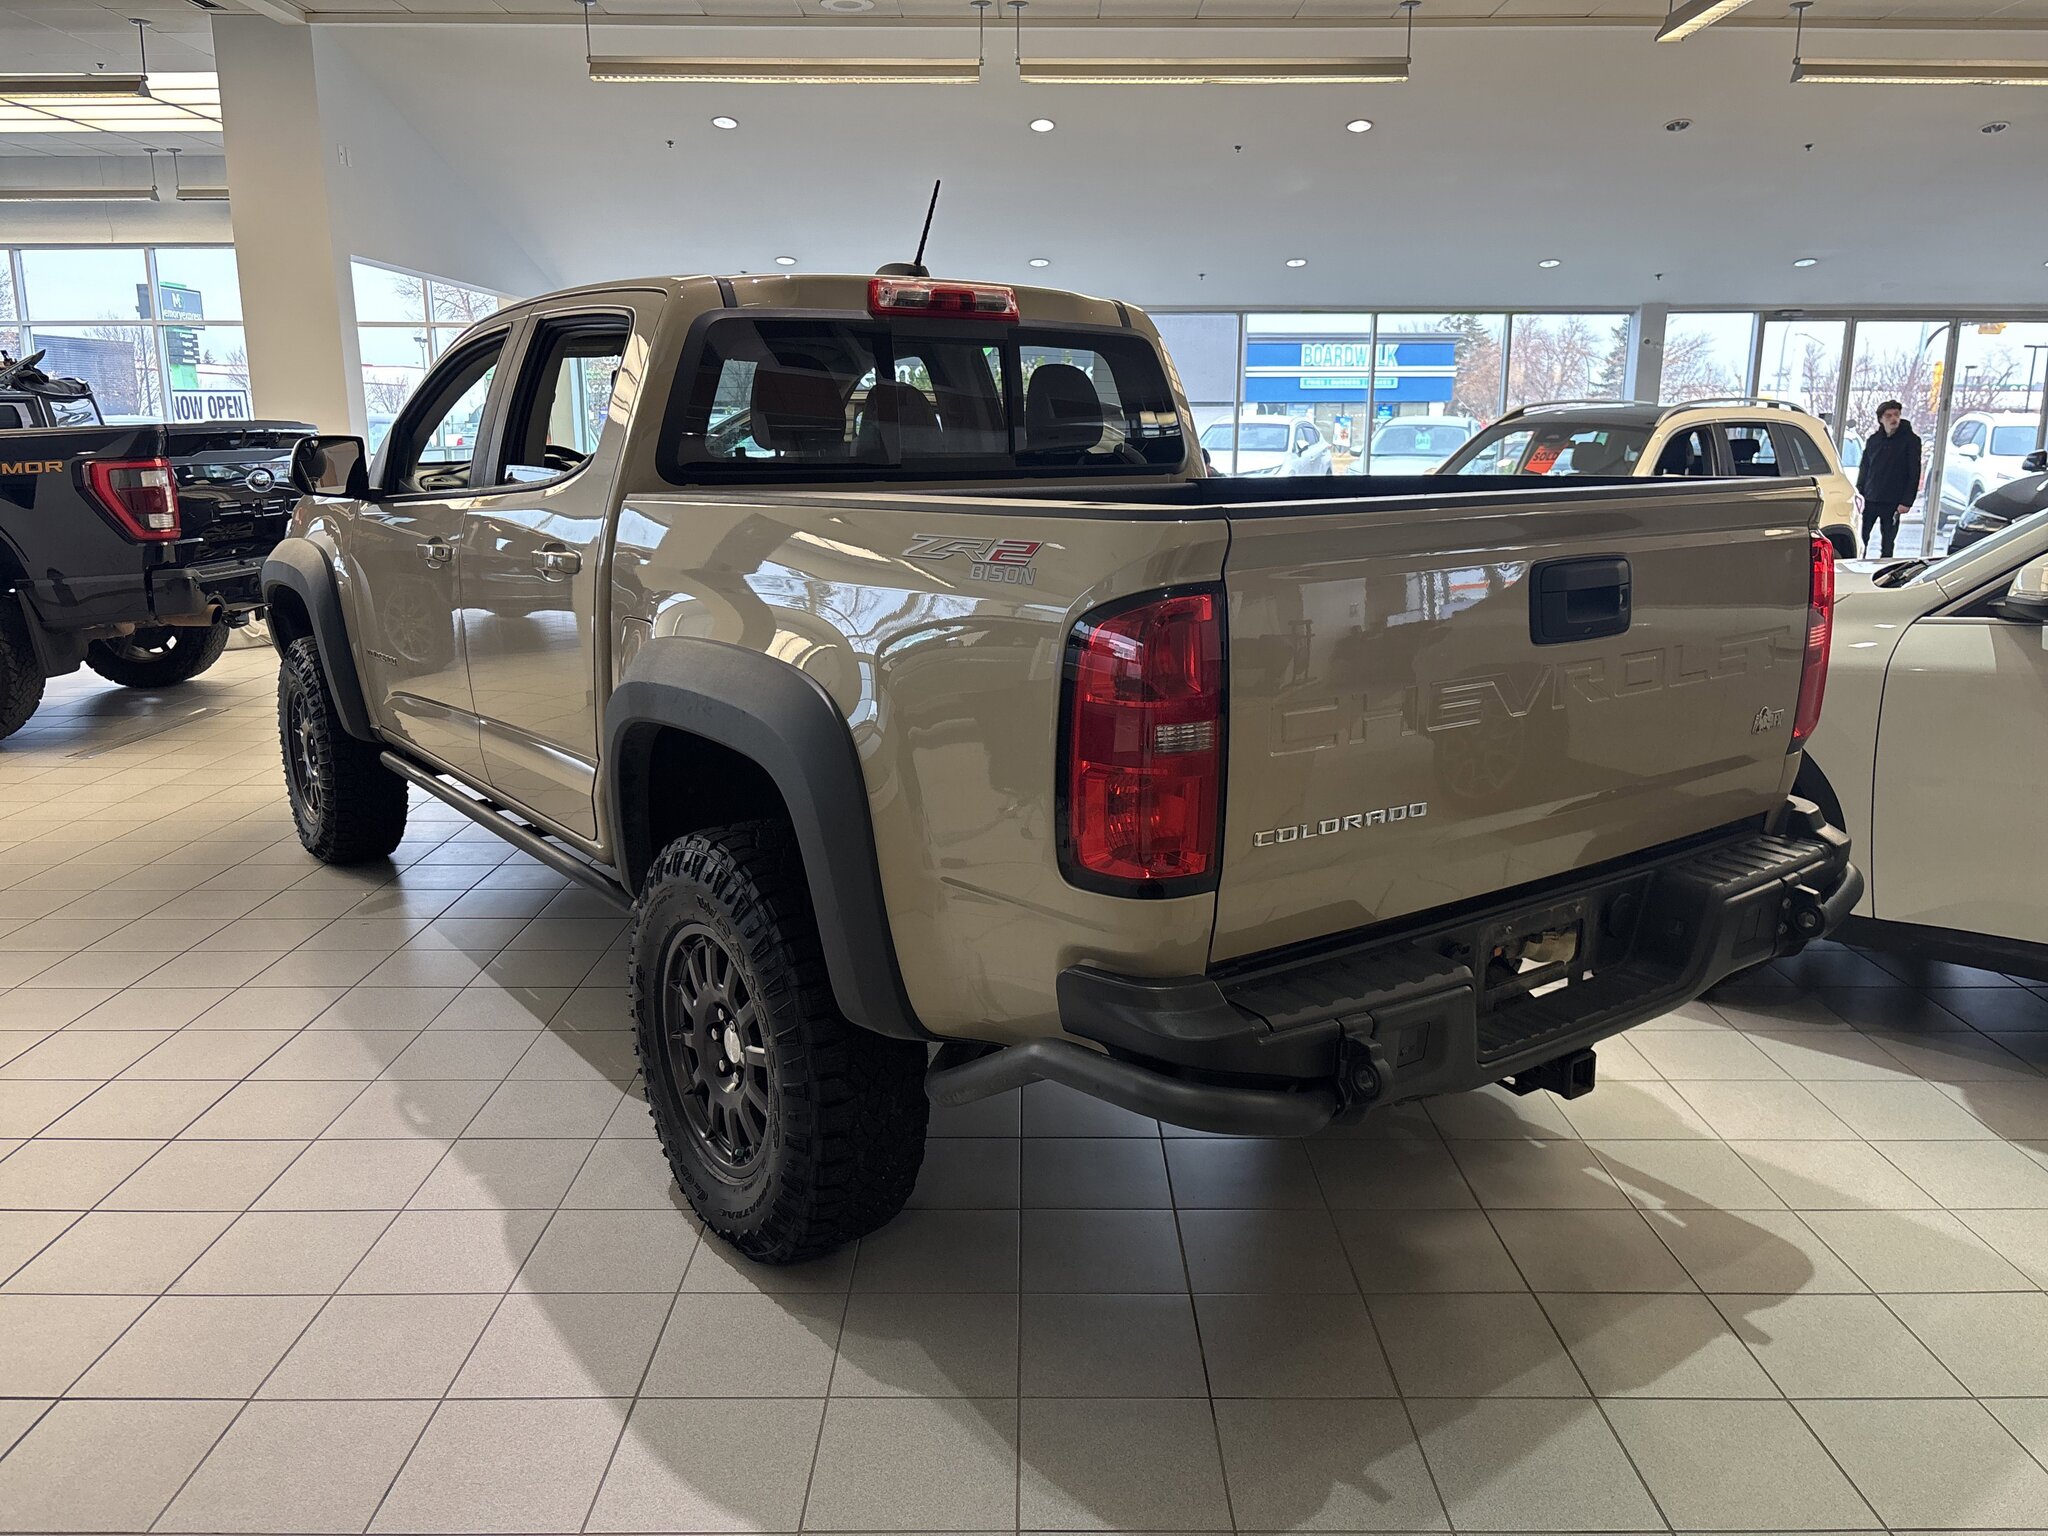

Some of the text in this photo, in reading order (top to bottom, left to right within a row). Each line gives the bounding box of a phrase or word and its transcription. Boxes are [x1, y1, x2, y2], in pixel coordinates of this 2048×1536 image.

[1301, 343, 1400, 367] BOARDWLK
[174, 396, 244, 420] NOW OPEN
[1, 461, 64, 475] MOR
[1532, 451, 1559, 462] SOLD
[901, 533, 1044, 566] ZR2
[970, 564, 1037, 585] BISON
[1270, 625, 1791, 757] CHEVROLET
[1253, 802, 1428, 848] COLORADO
